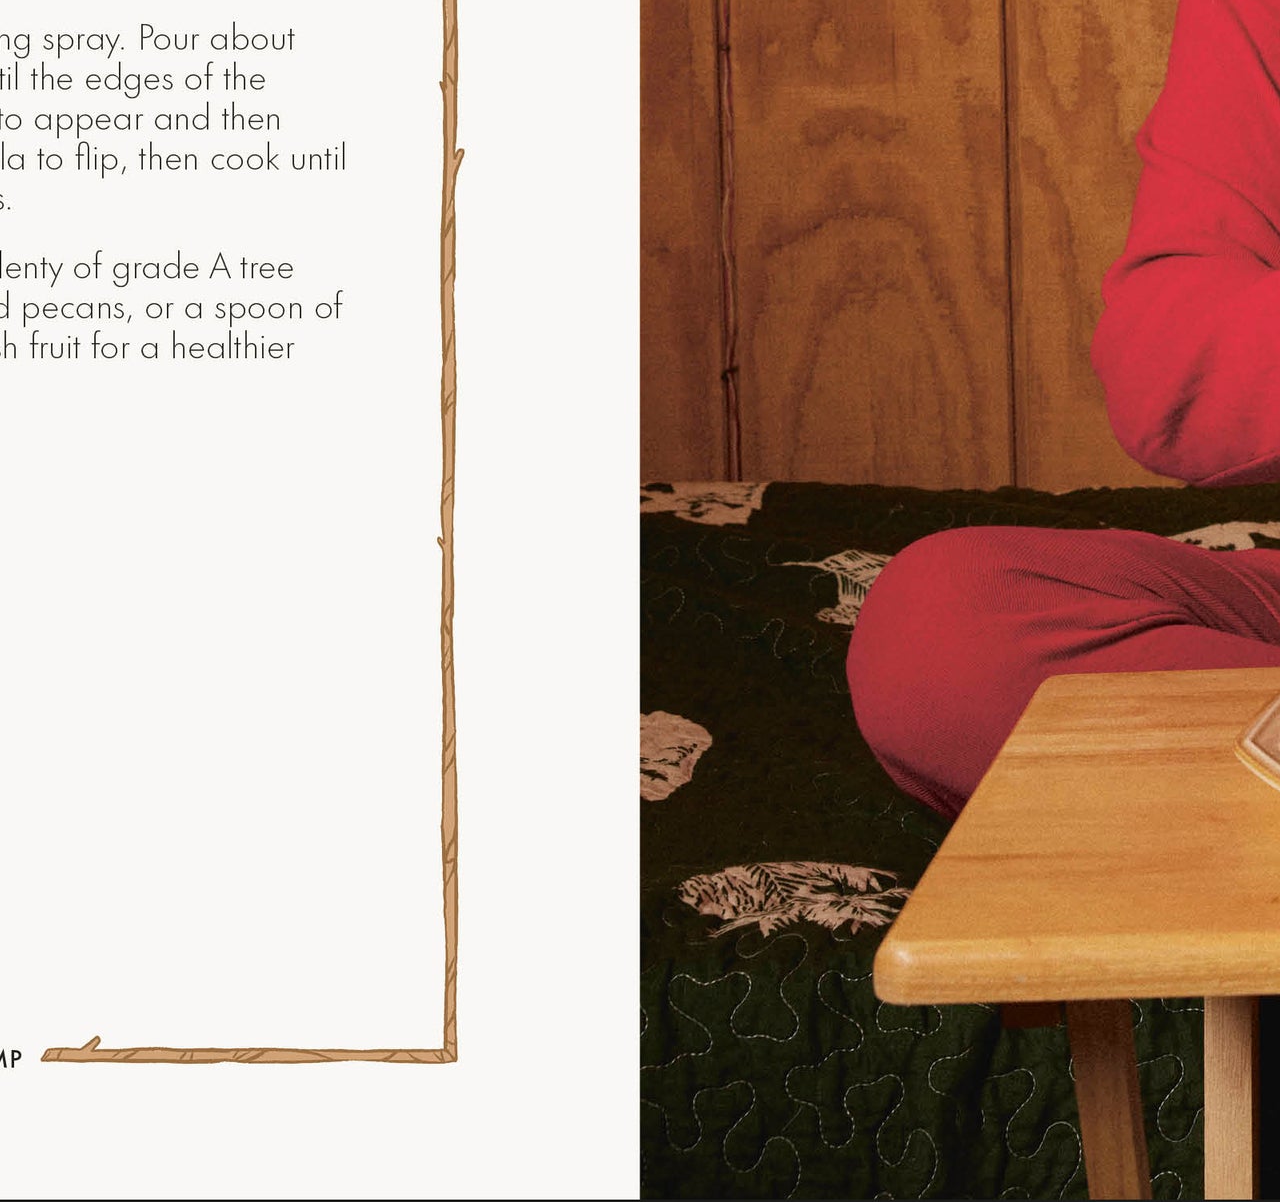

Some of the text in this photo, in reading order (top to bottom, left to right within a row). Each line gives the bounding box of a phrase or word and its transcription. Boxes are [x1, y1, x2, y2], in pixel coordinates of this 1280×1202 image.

[36, 147, 63, 171] to
[74, 140, 127, 180] flip,
[138, 140, 198, 171] then
[210, 140, 280, 171] cook
[291, 140, 346, 171] until
